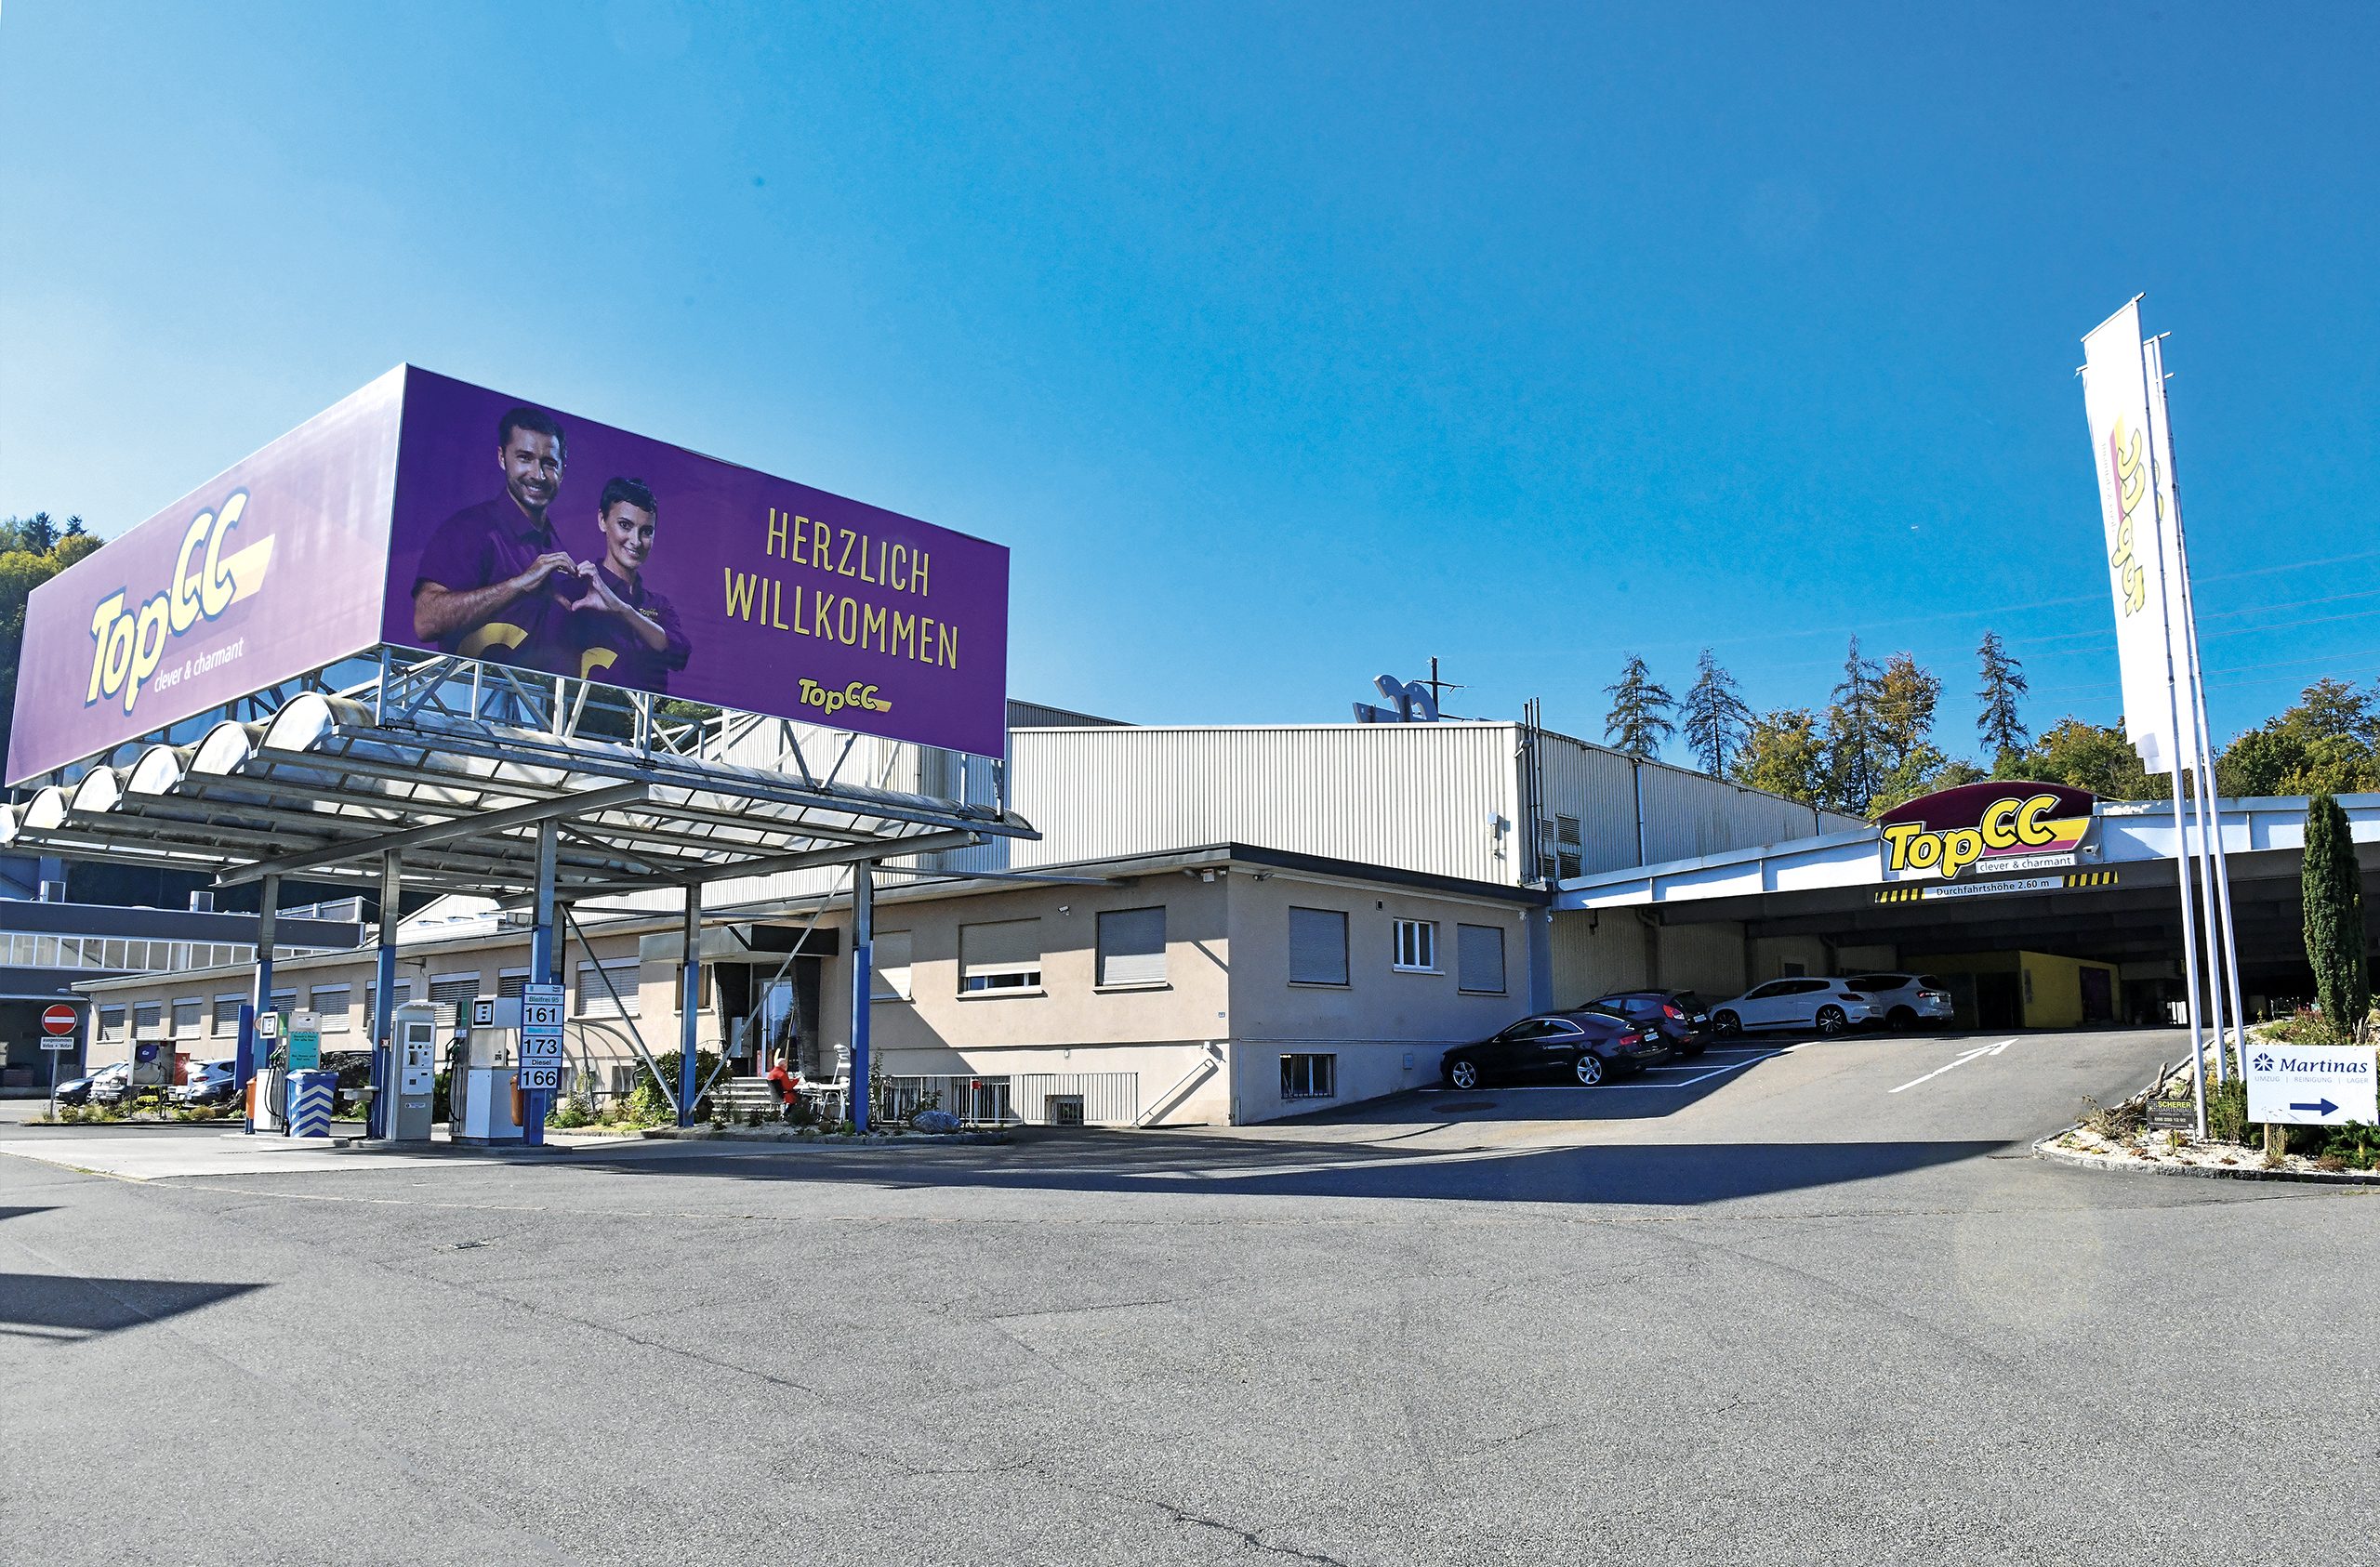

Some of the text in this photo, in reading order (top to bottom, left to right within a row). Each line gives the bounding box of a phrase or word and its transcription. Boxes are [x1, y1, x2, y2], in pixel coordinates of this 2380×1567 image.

[766, 507, 929, 597] HERZLICH
[85, 487, 249, 717] TopCC
[724, 567, 958, 669] WILLKOMMEN
[154, 638, 244, 692] clever & charmant
[798, 678, 879, 715] TopCC
[1882, 795, 2061, 879] TopCC
[1979, 856, 2071, 872] clever & charmant
[1937, 880, 2016, 896] Durchfahrtshöhe
[2017, 880, 2038, 889] 2.60
[525, 1007, 556, 1022] 161
[523, 1039, 558, 1055] 173
[522, 1071, 557, 1086] 166
[2280, 1058, 2368, 1073] Martinas
